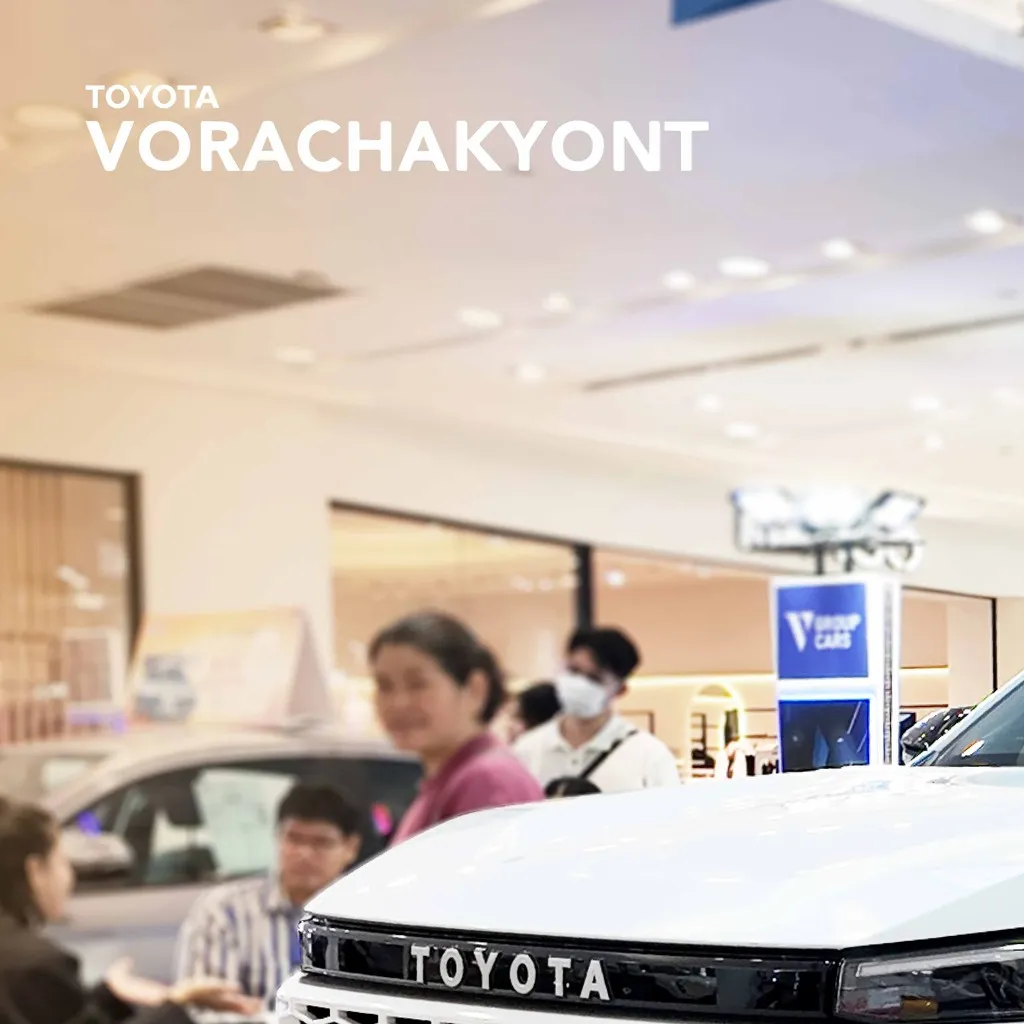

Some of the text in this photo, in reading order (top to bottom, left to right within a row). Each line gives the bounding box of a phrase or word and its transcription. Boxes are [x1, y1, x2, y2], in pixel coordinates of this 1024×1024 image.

[785, 611, 814, 652] V
[814, 633, 851, 650] CARS
[411, 945, 611, 1001] TOYOTA
